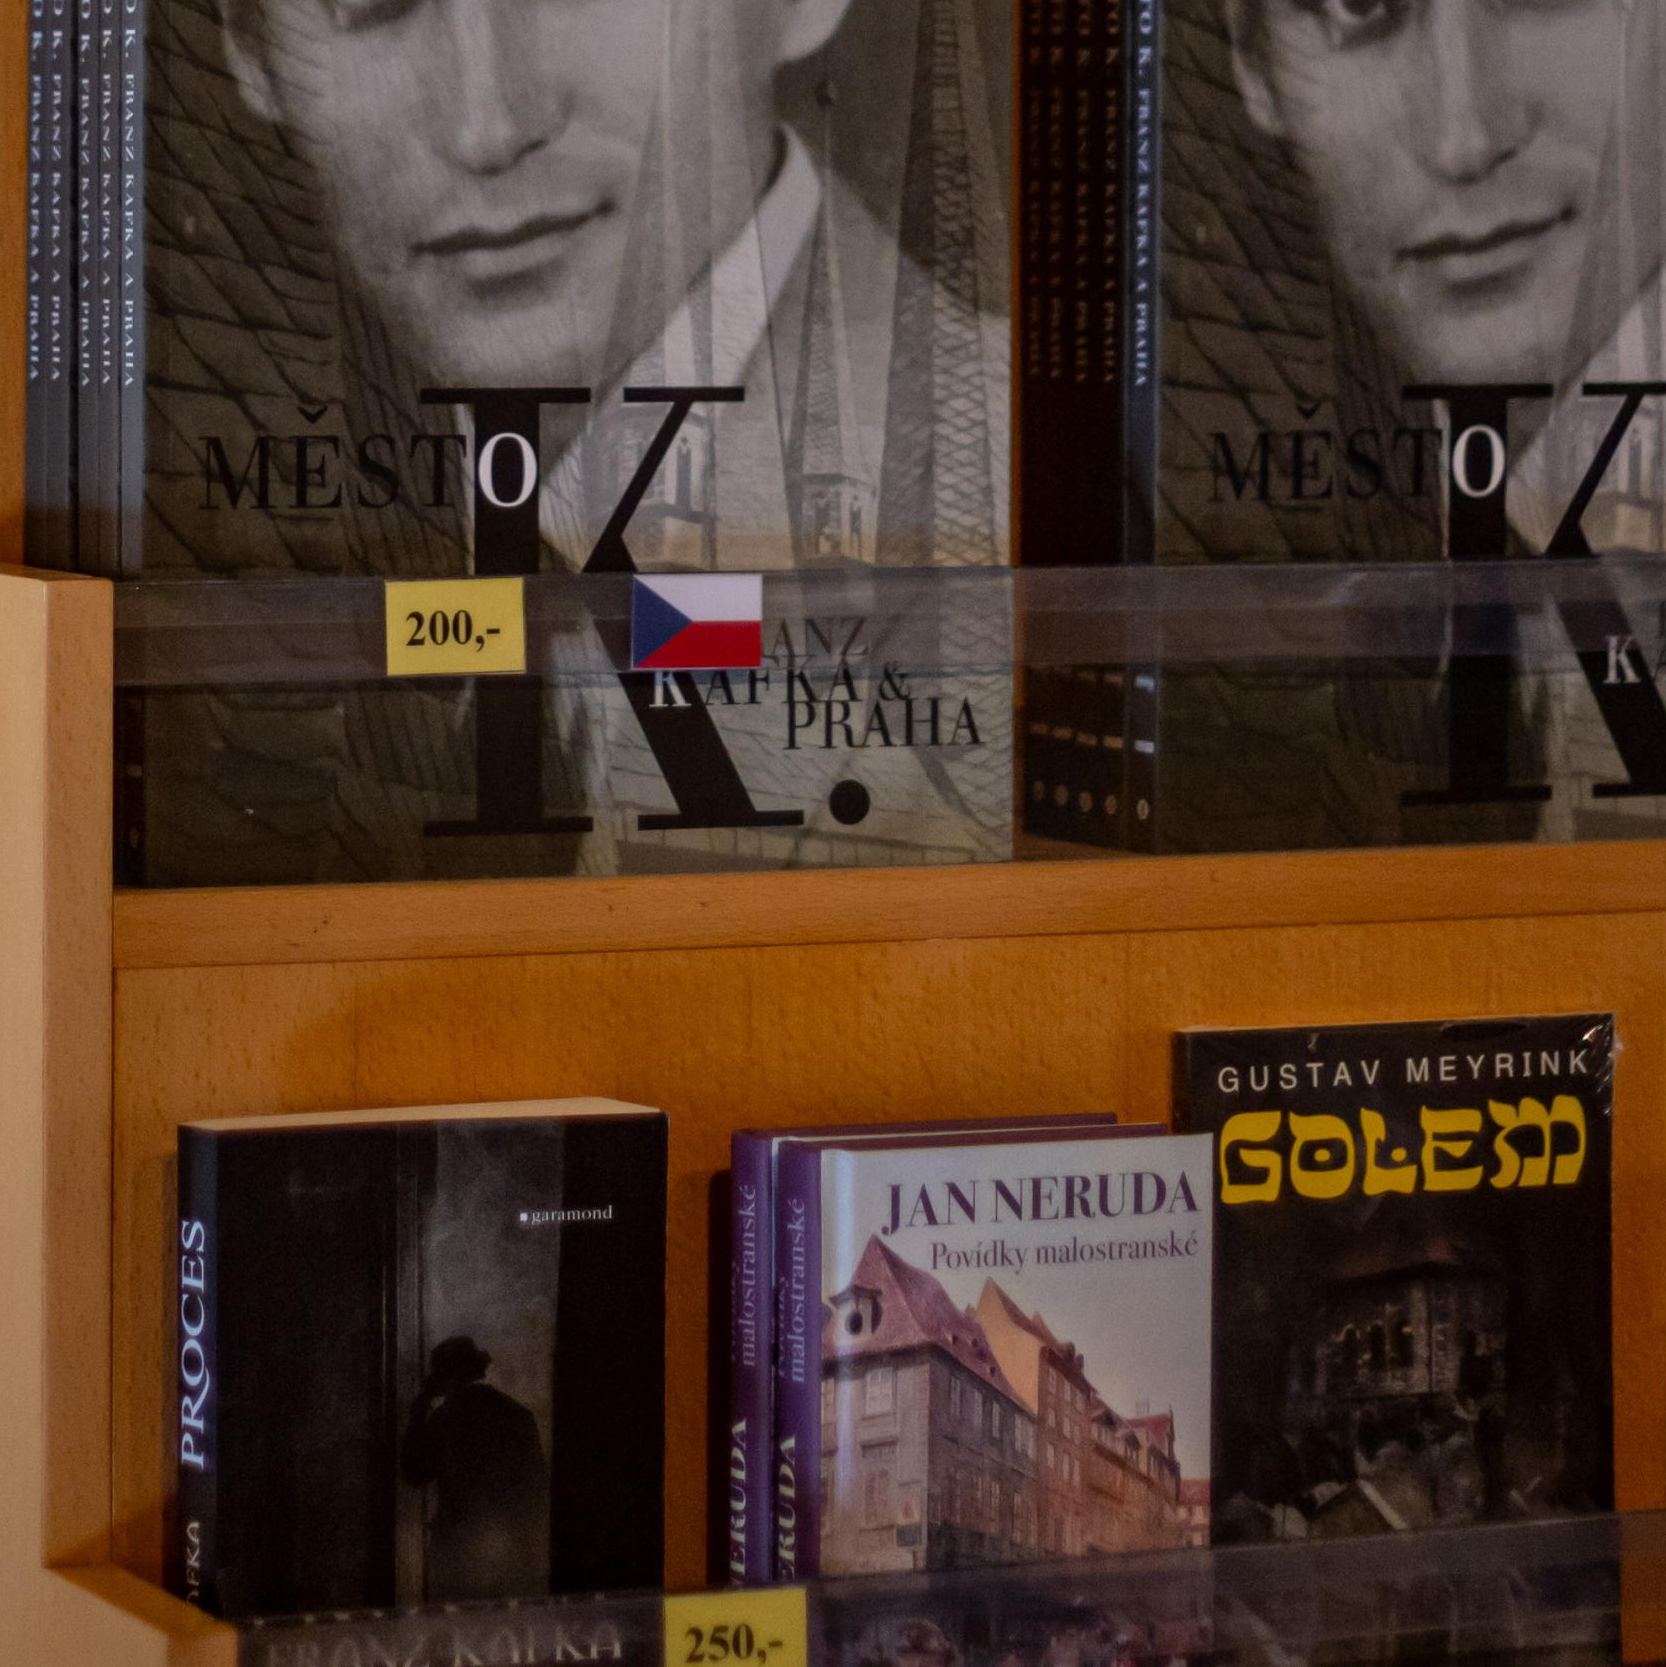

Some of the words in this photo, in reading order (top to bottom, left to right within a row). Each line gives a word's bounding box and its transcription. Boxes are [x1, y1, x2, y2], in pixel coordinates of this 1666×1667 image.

[198, 405, 538, 511] MĚSTO
[1209, 401, 1506, 503] MĚSTO
[404, 607, 502, 651] 200,-
[878, 661, 911, 702] &
[782, 695, 985, 750] PRAHA
[1217, 1058, 1381, 1094] GUSTAV
[1405, 1047, 1589, 1085] MEYRINK
[1219, 1094, 1587, 1206] GOLEM
[531, 1204, 613, 1226] garamond
[880, 1179, 980, 1236] JAN
[990, 1169, 1202, 1224] NERUDA
[931, 1237, 1029, 1276] Povídky
[1036, 1229, 1199, 1266] malostranské
[787, 1197, 805, 1382] malostranské
[180, 1219, 210, 1471] PROCES
[685, 1623, 783, 1664] 250,-
